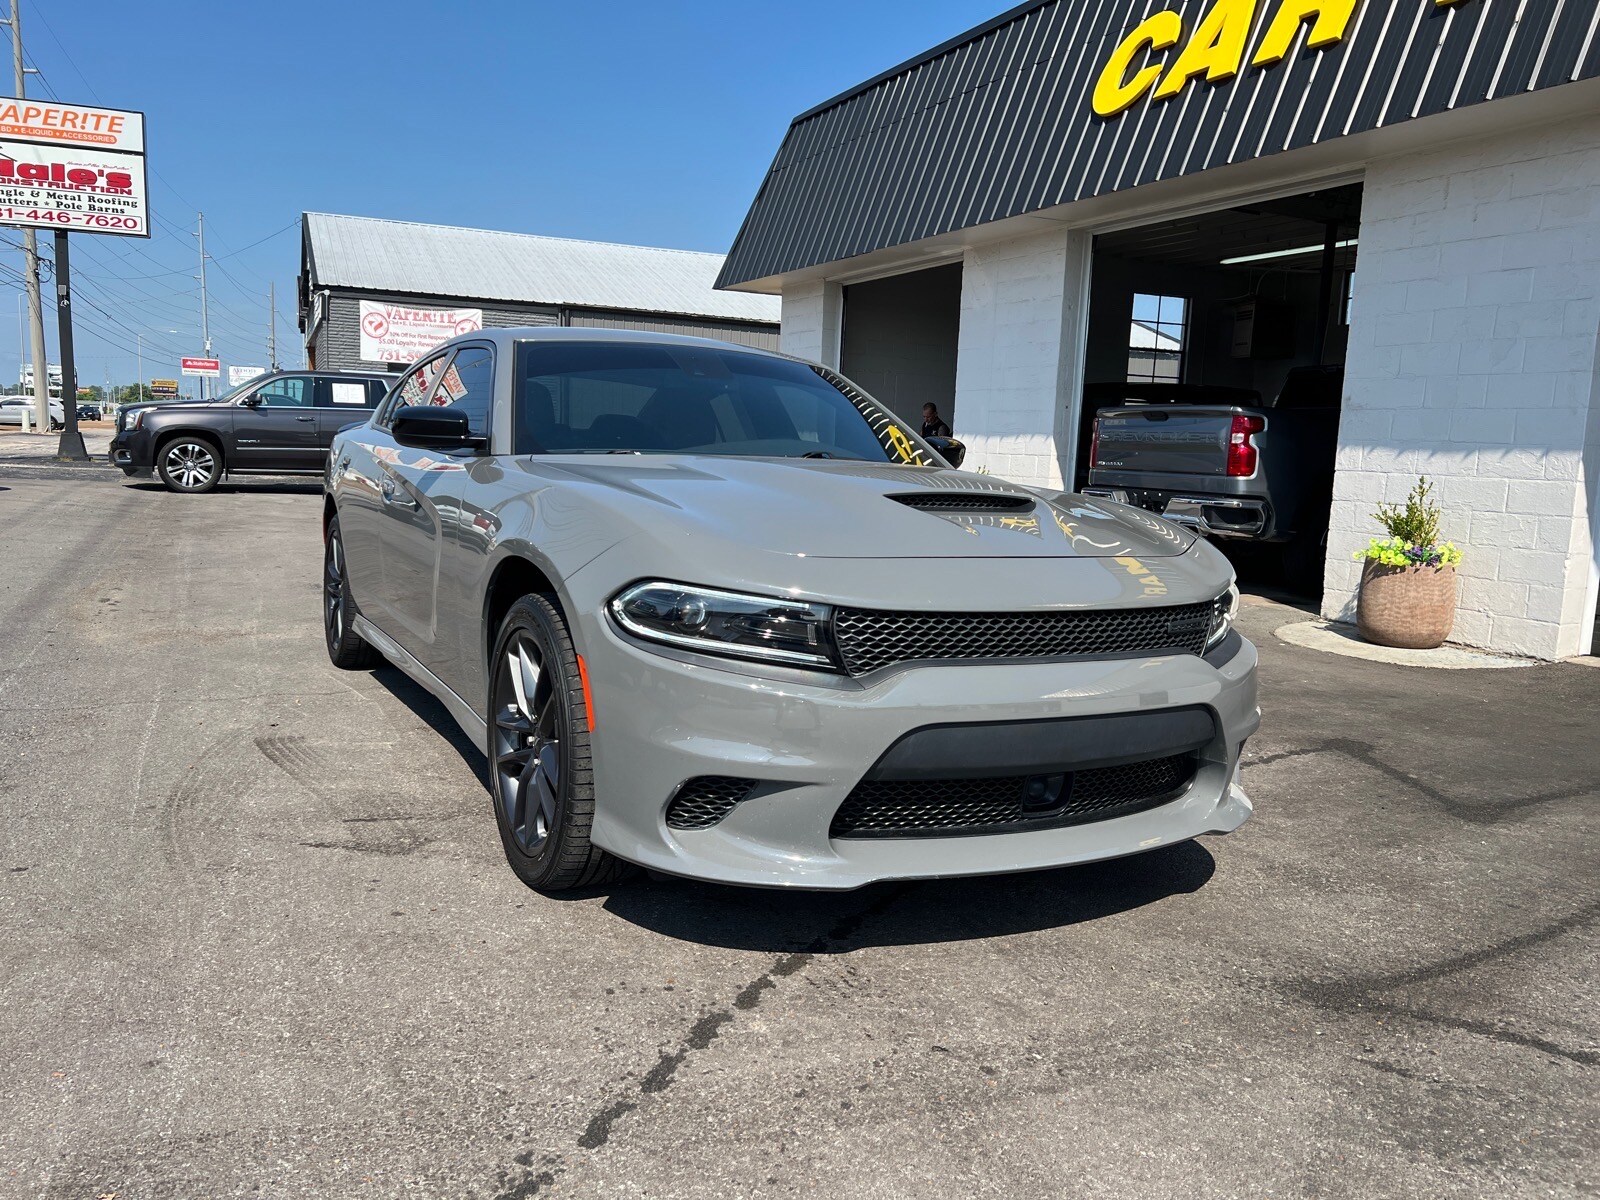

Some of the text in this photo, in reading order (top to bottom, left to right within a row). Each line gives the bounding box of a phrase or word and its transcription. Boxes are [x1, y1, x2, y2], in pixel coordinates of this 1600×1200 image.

[0, 103, 125, 133] APER!TE
[20, 127, 54, 137] E-LIQUID
[62, 131, 116, 143] ACCESSORIES
[0, 189, 138, 209] ngle & Metal Roofing
[0, 198, 125, 214] utters Pole Barns
[0, 207, 138, 229] 1-446-7620
[396, 340, 417, 348] Loyalty
